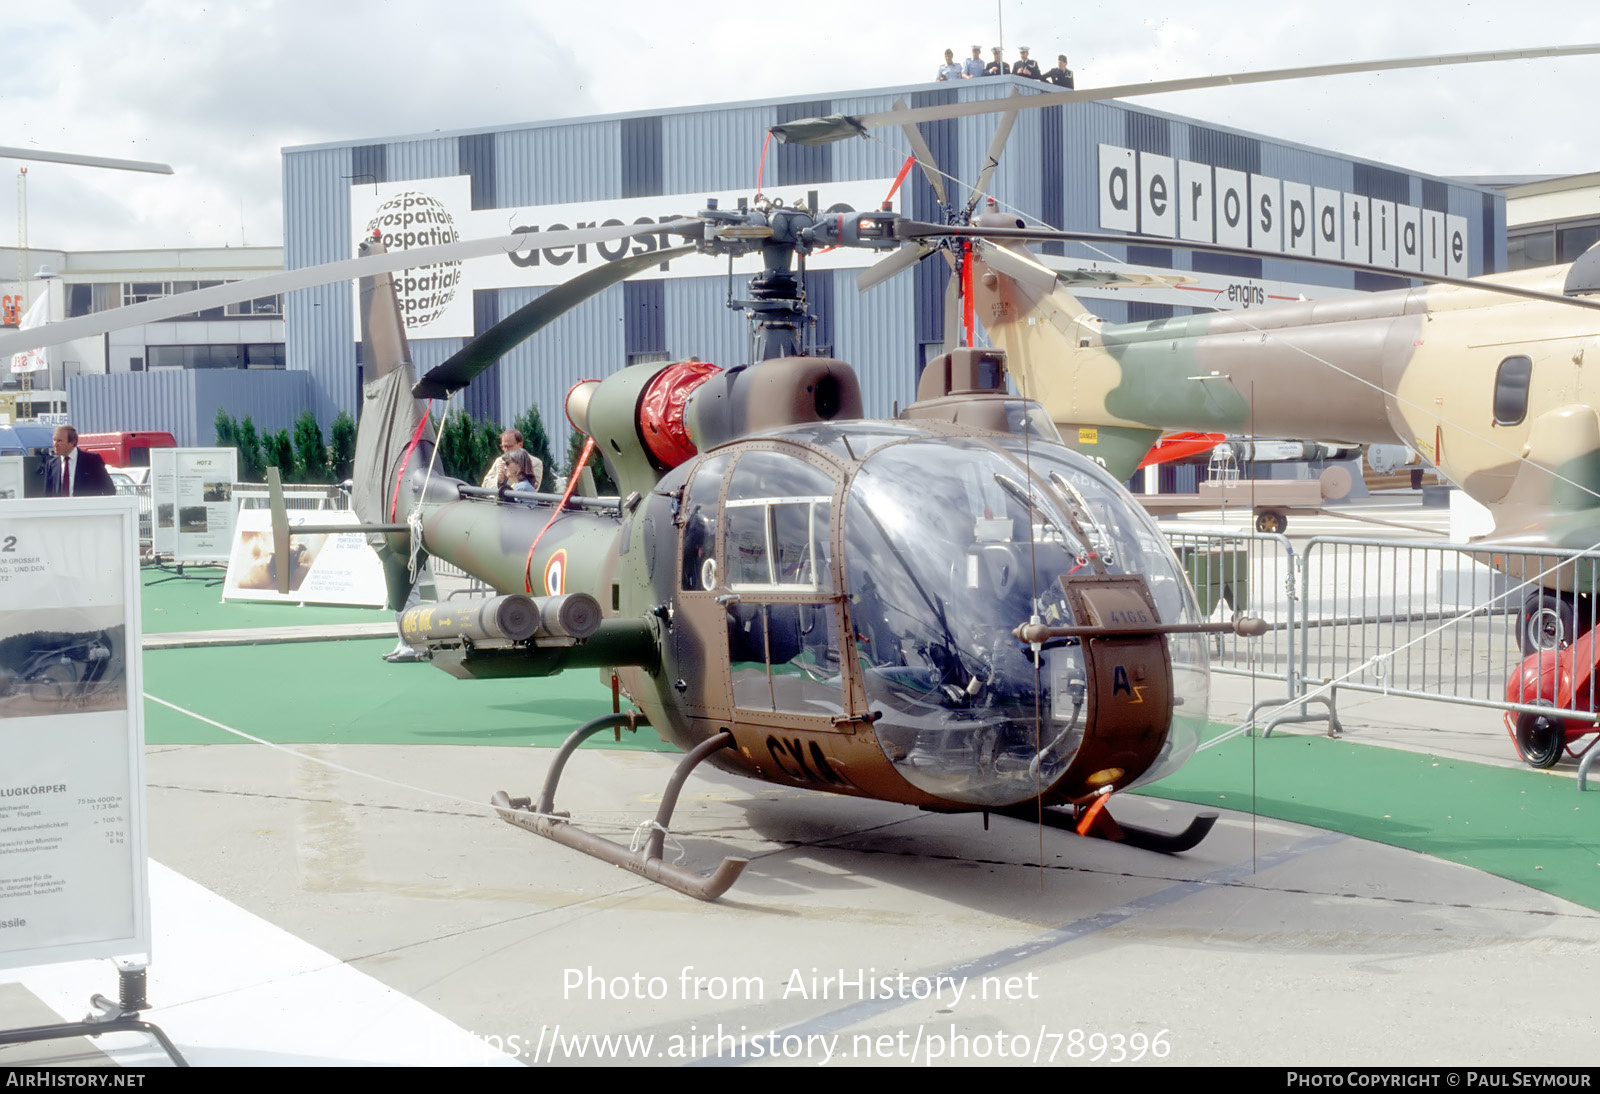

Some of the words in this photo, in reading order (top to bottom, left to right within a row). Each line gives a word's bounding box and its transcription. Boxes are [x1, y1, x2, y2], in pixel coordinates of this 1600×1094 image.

[1108, 165, 1464, 265] aerospatiale
[1228, 280, 1264, 309] engins
[1080, 432, 1097, 440] DANGER
[2, 535, 17, 552] 2
[1112, 665, 1131, 697] A
[0, 784, 67, 798] LUGKÖRPER
[33, 879, 67, 888] Frankreich
